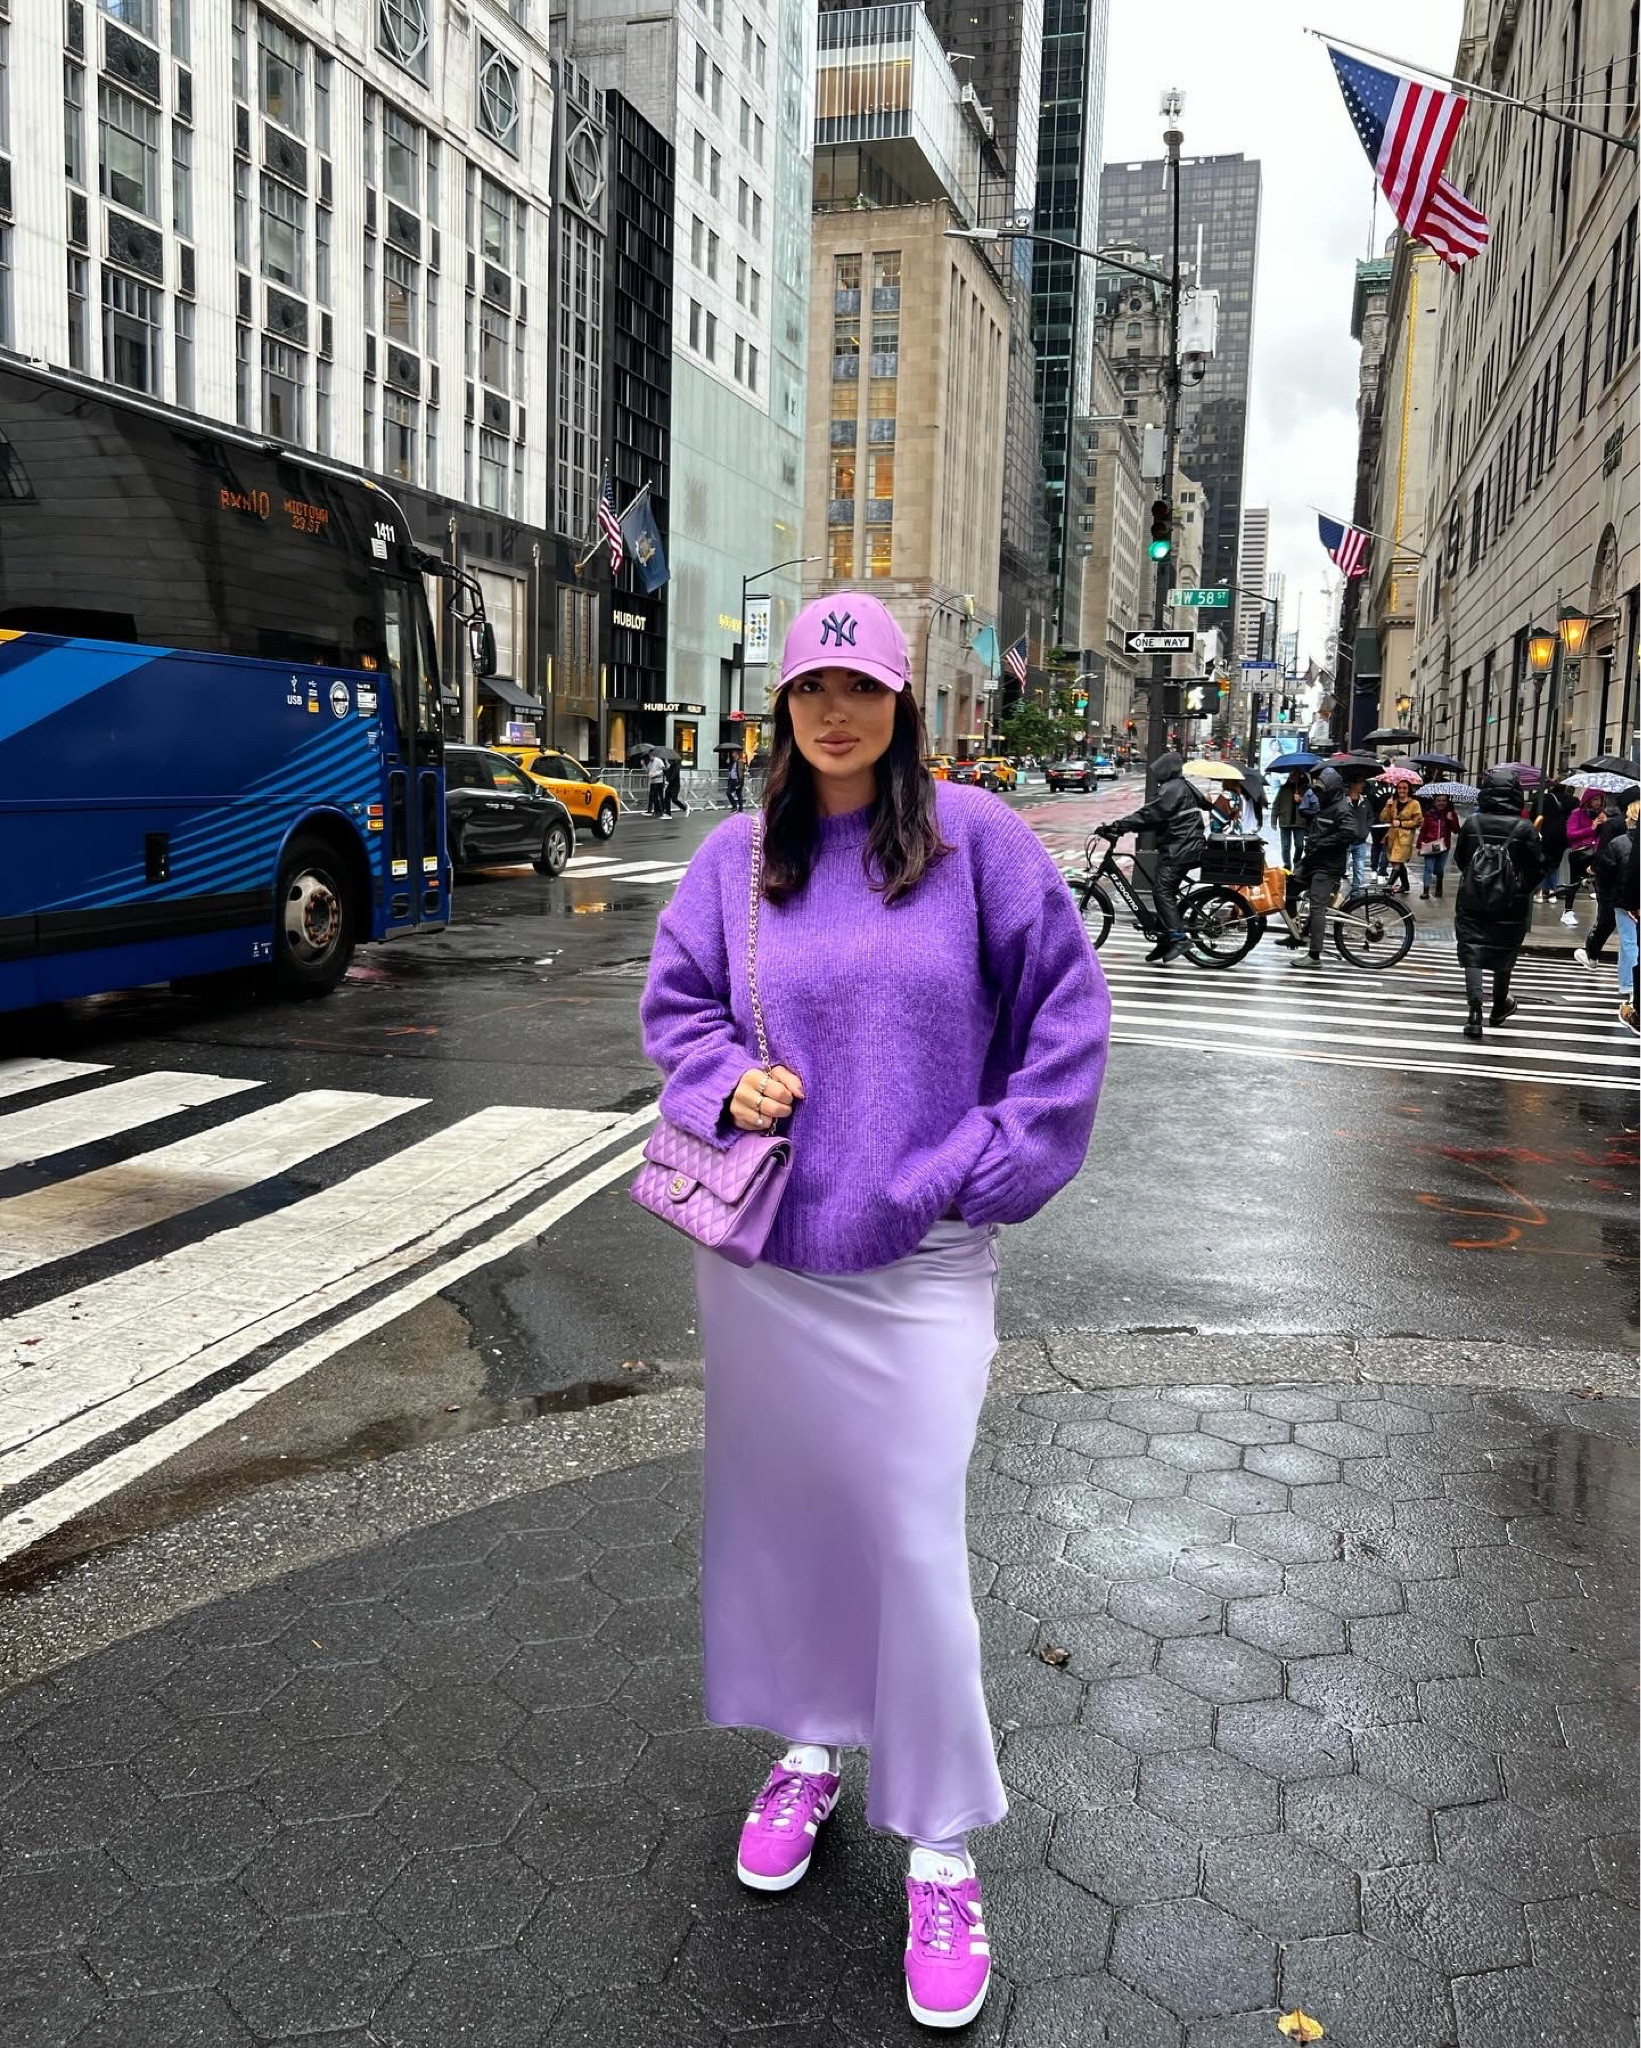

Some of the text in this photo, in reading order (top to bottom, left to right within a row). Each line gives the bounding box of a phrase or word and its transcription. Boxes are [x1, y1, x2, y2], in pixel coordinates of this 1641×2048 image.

[374, 521, 395, 543] 1411
[1184, 591, 1227, 605] W 58 ST
[613, 609, 647, 631] HUBLOT
[820, 611, 858, 647] NY
[1135, 638, 1186, 648] ONE WAY
[287, 694, 303, 705] USB
[644, 702, 680, 712] HUBLOT
